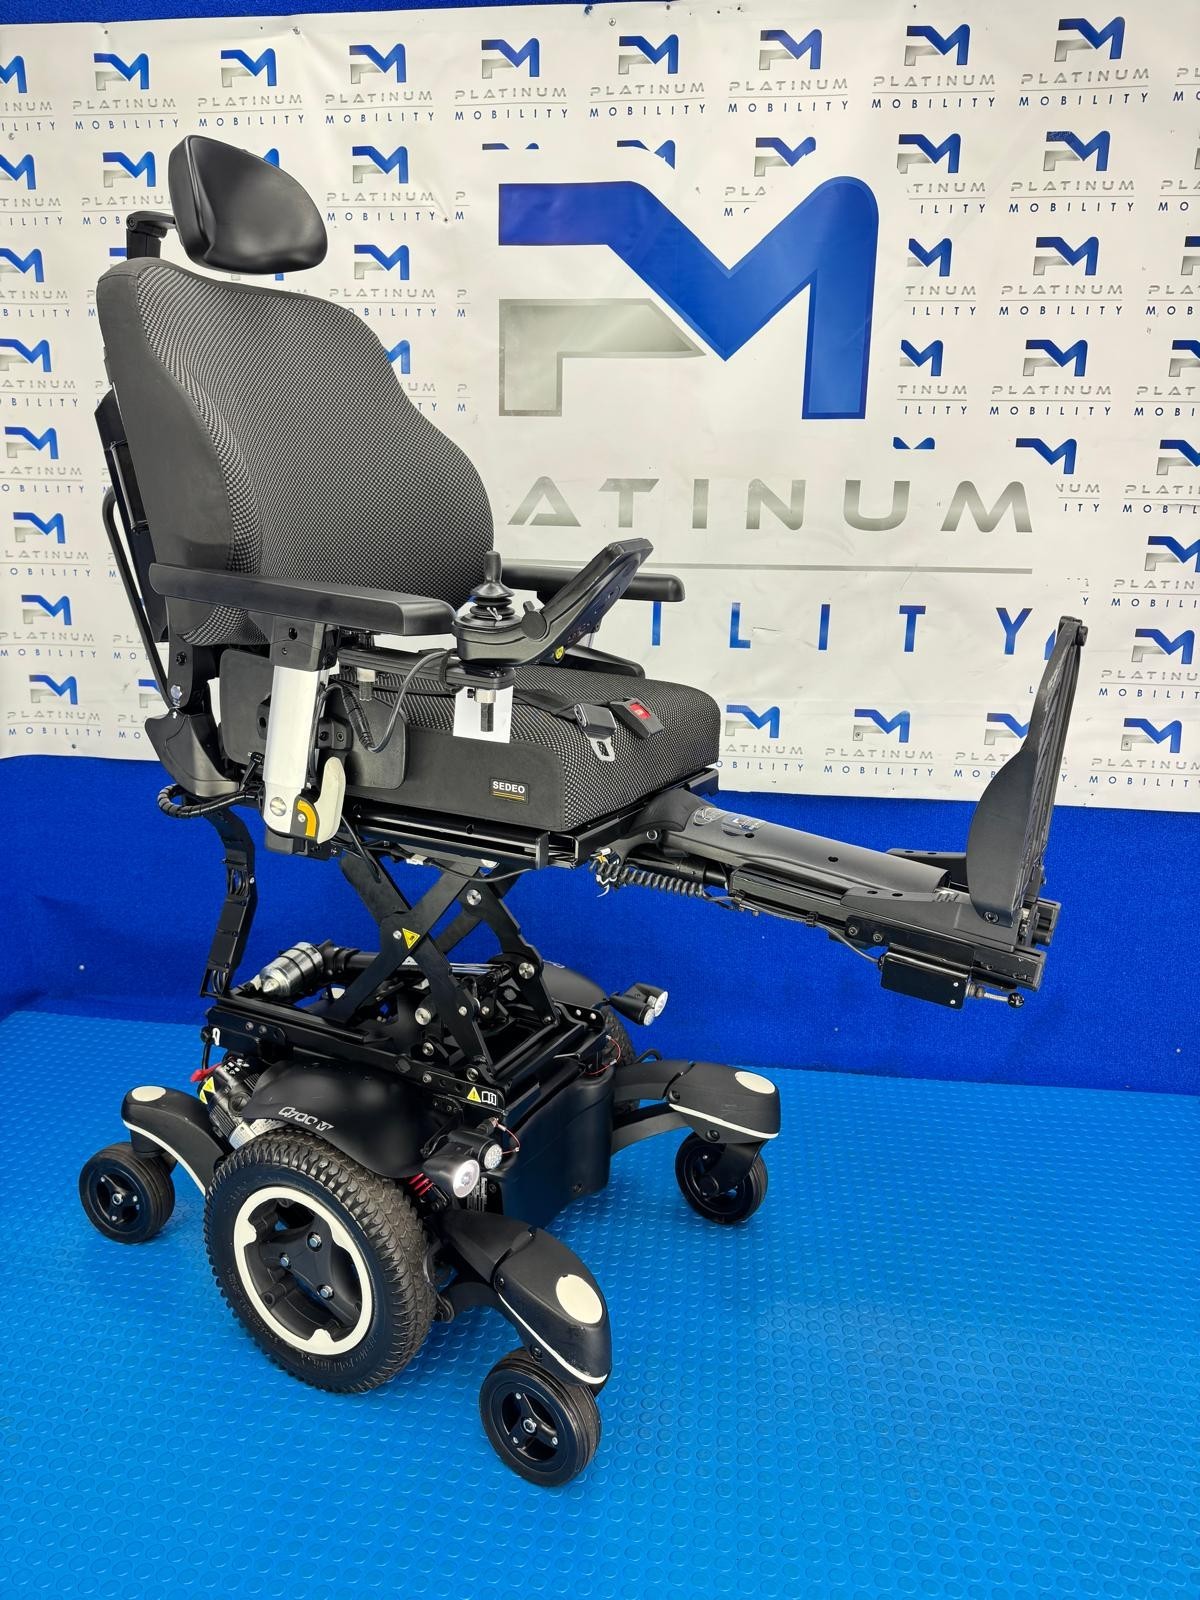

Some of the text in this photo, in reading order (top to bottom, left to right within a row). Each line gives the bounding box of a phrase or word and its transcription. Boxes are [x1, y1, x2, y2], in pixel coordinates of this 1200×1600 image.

[873, 74, 996, 87] PLATINUM
[1020, 67, 1149, 85] PLATINUM
[589, 82, 705, 96] PLATINUM
[729, 78, 848, 92] PLATINUM
[325, 90, 433, 103] PLATINUM
[455, 87, 567, 98] PLATINUM
[72, 98, 177, 110] PLATINUM
[198, 94, 303, 107] PLATINUM
[871, 97, 996, 109] MOBILITY
[1018, 92, 1149, 107] MOBILITY
[5, 101, 53, 111] INUM
[589, 104, 706, 117] MOBILITY
[728, 100, 849, 113] MOBILITY
[325, 112, 434, 124] MOBILITY
[455, 108, 568, 120] MOBILITY
[75, 119, 180, 130] MOBILITY
[199, 115, 304, 127] MOBILITY
[906, 182, 986, 193] TINUM
[1010, 179, 1135, 191] PLATINUM
[82, 195, 171, 206] PLATINU
[326, 192, 435, 202] PLATINUM
[920, 203, 986, 214] ILITY
[1008, 202, 1134, 213] MOBILITY
[1158, 201, 1189, 211] MO
[10, 216, 63, 226] ILITY
[327, 212, 436, 222] MOBILITY
[0, 290, 68, 299] TINUM
[329, 288, 435, 298] PLATINUM
[905, 285, 976, 295] TINUM
[1001, 284, 1123, 295] PLATINUM
[1148, 285, 1200, 294] PLA
[3, 309, 72, 318] BILITY
[912, 306, 977, 316] ILITY
[998, 305, 1123, 316] MOBILITY
[1145, 306, 1193, 315] MOB
[897, 385, 968, 395] TINUM
[991, 385, 1112, 395] PLATINUM
[1136, 386, 1196, 396] PLAT
[904, 406, 968, 415] ILITY
[990, 406, 1111, 416] MOBILITY
[1134, 407, 1195, 416] MOBI
[2, 484, 85, 493] OBILITY
[1125, 485, 1200, 494] PLATI
[507, 475, 1034, 533] ATINUM
[1064, 503, 1100, 512] ITY
[5, 550, 89, 559] LATINUM
[10, 568, 91, 577] OBILITY
[1113, 579, 1195, 589] PLATIN
[1111, 598, 1197, 608] MOBILI
[651, 600, 1034, 655] ILITY
[0, 632, 95, 642] PLATINUM
[0, 649, 97, 658] MOBILITY
[1101, 669, 1199, 681] PLATINU
[7, 710, 101, 721] PLATINUM
[8, 727, 102, 737] MOBILITY
[824, 748, 934, 760] PLATINUM
[823, 764, 934, 777] MOBILITY
[492, 780, 526, 794] SEDEO
[1089, 775, 1200, 788] MOBILIT
